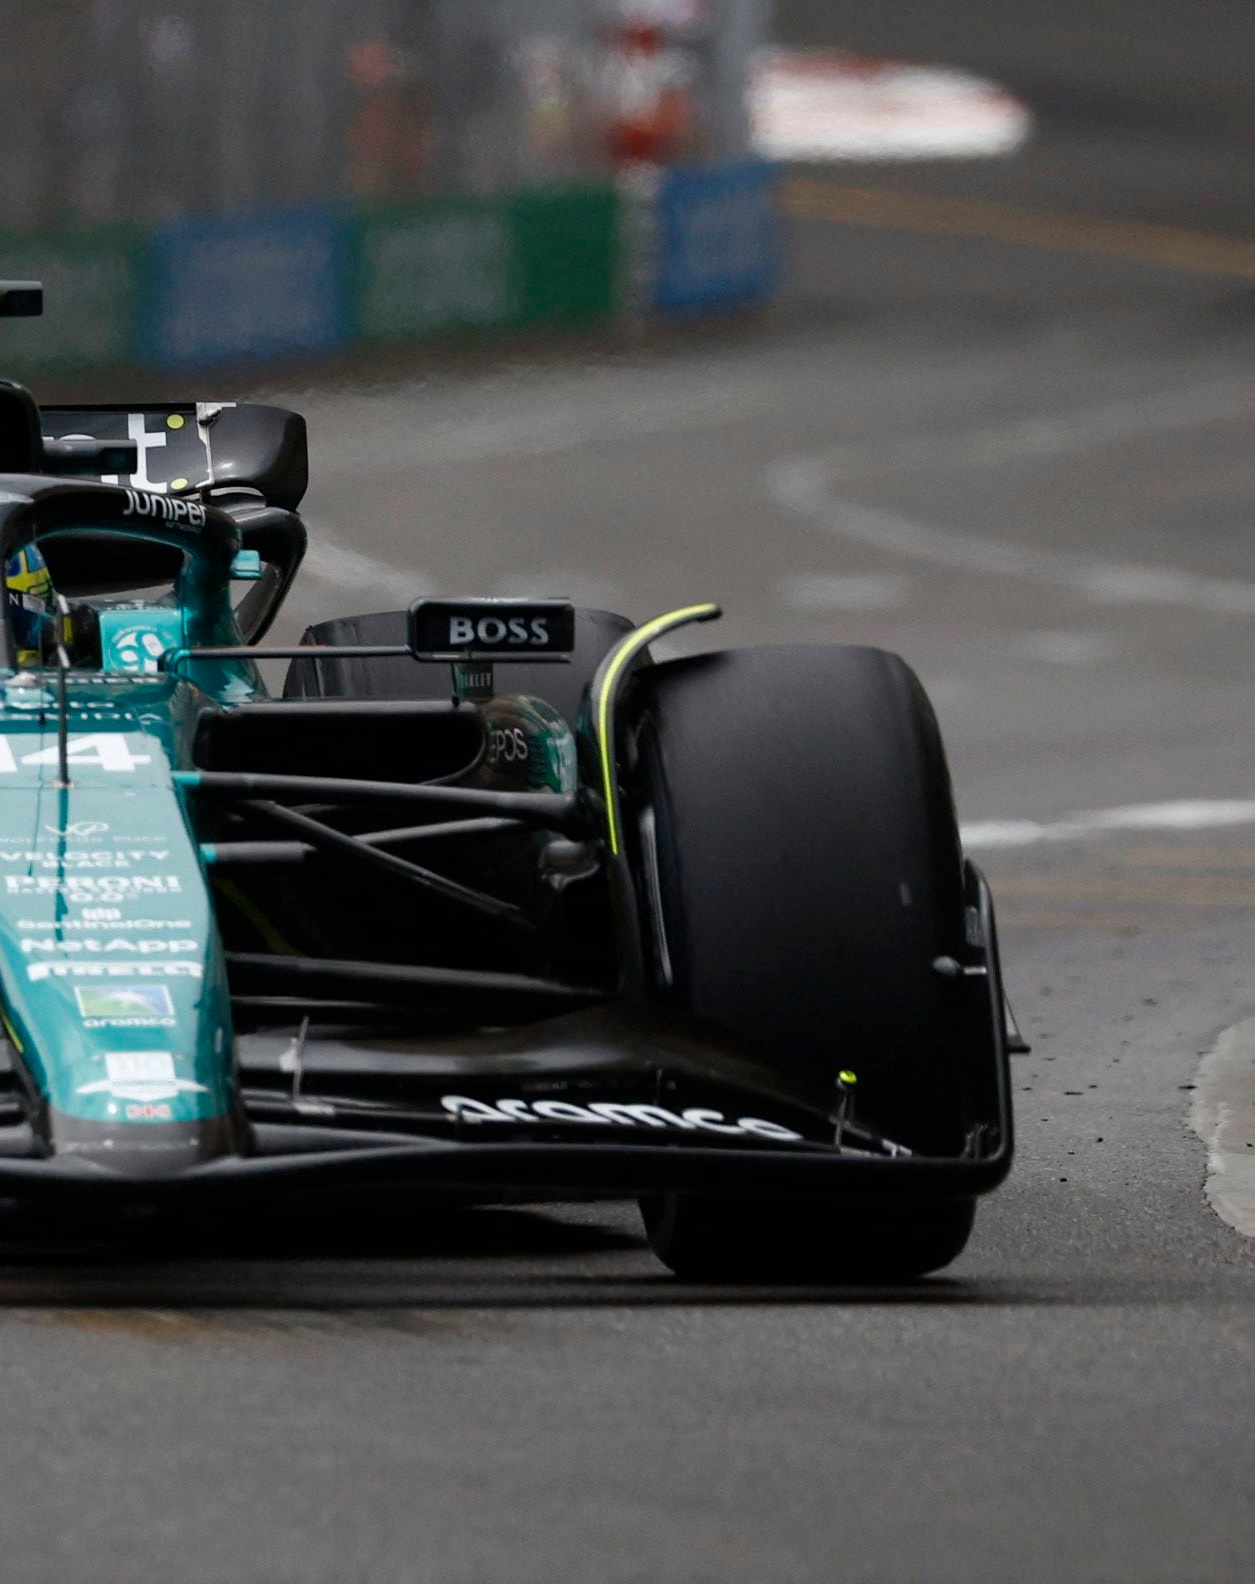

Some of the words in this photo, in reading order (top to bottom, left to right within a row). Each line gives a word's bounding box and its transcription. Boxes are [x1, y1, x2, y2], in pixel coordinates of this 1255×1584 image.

[449, 615, 549, 645] BOSS
[4, 875, 182, 888] PERONI
[20, 938, 199, 953] NetApp
[82, 1016, 177, 1028] aramco
[440, 1094, 804, 1142] aramco
